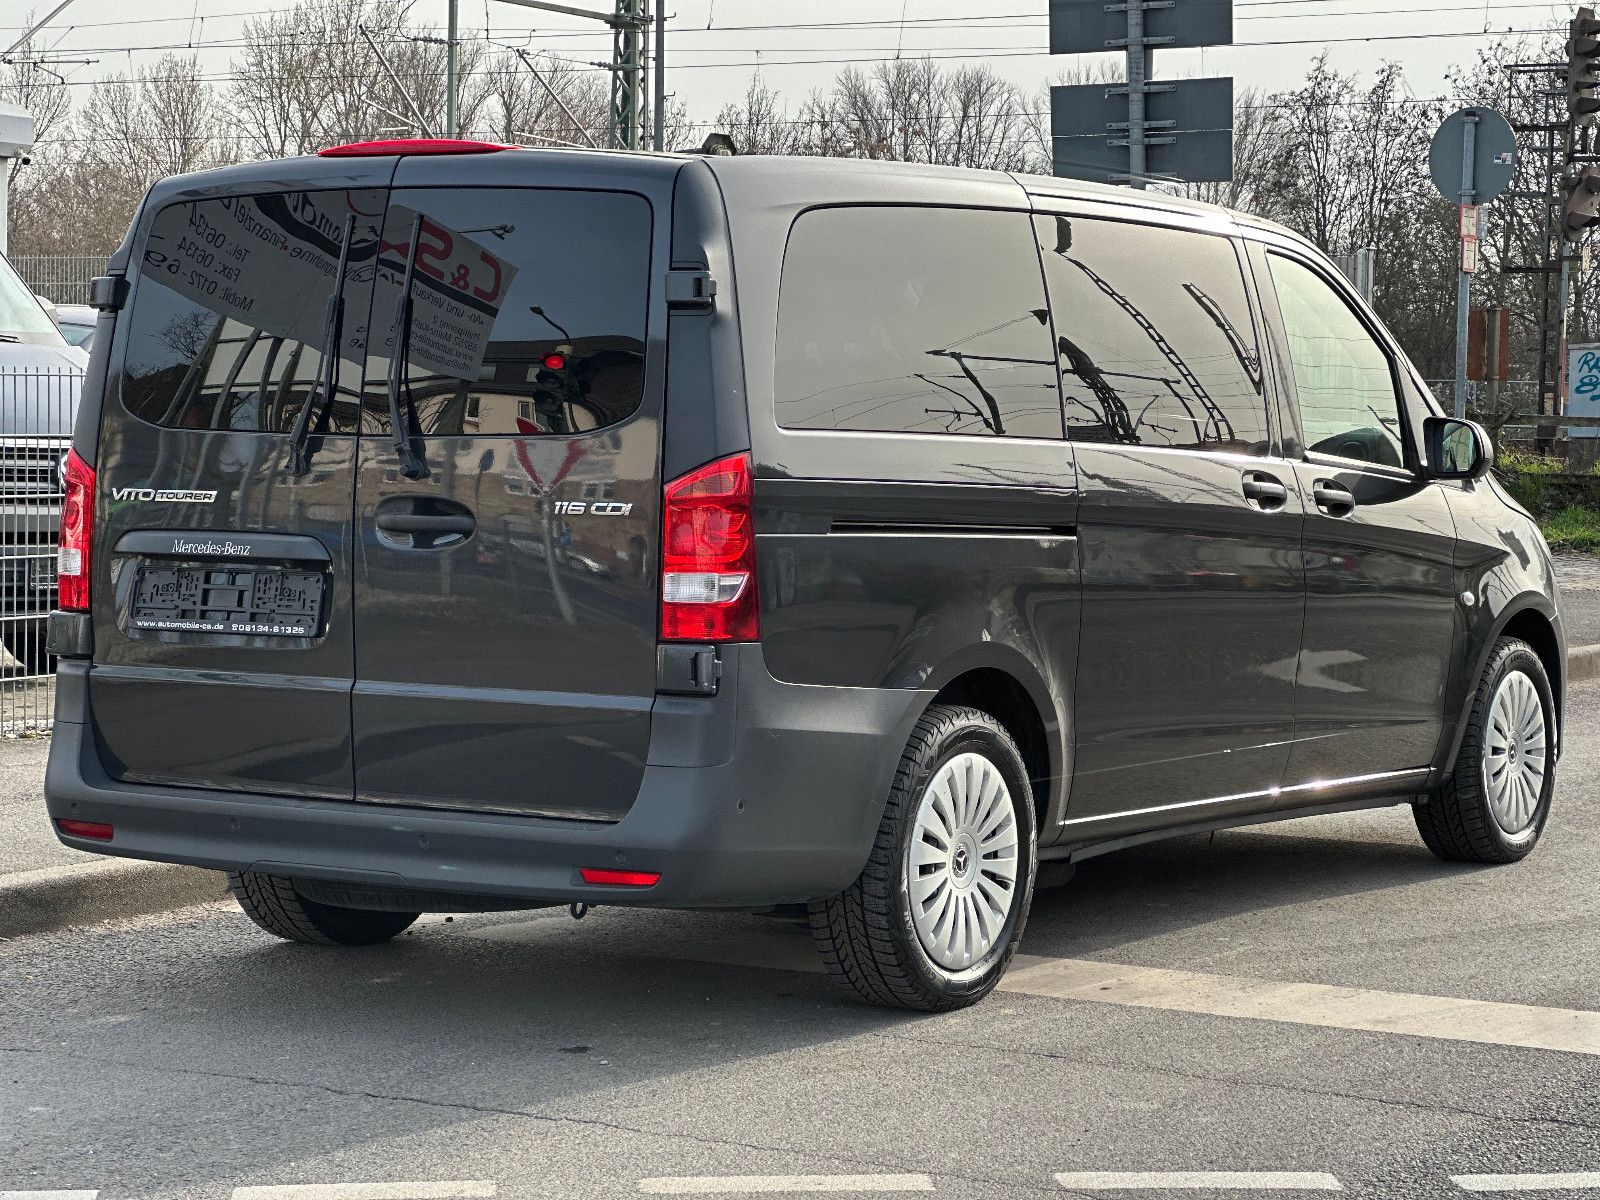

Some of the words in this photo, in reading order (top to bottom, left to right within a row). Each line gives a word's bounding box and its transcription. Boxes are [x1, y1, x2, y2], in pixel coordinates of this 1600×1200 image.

[112, 488, 155, 501] VITO
[157, 490, 214, 502] TOURER
[554, 501, 587, 515] 116
[590, 502, 633, 516] CDI
[171, 539, 251, 556] Mercedes-Benz
[136, 620, 224, 631] www.automobile-cs.de
